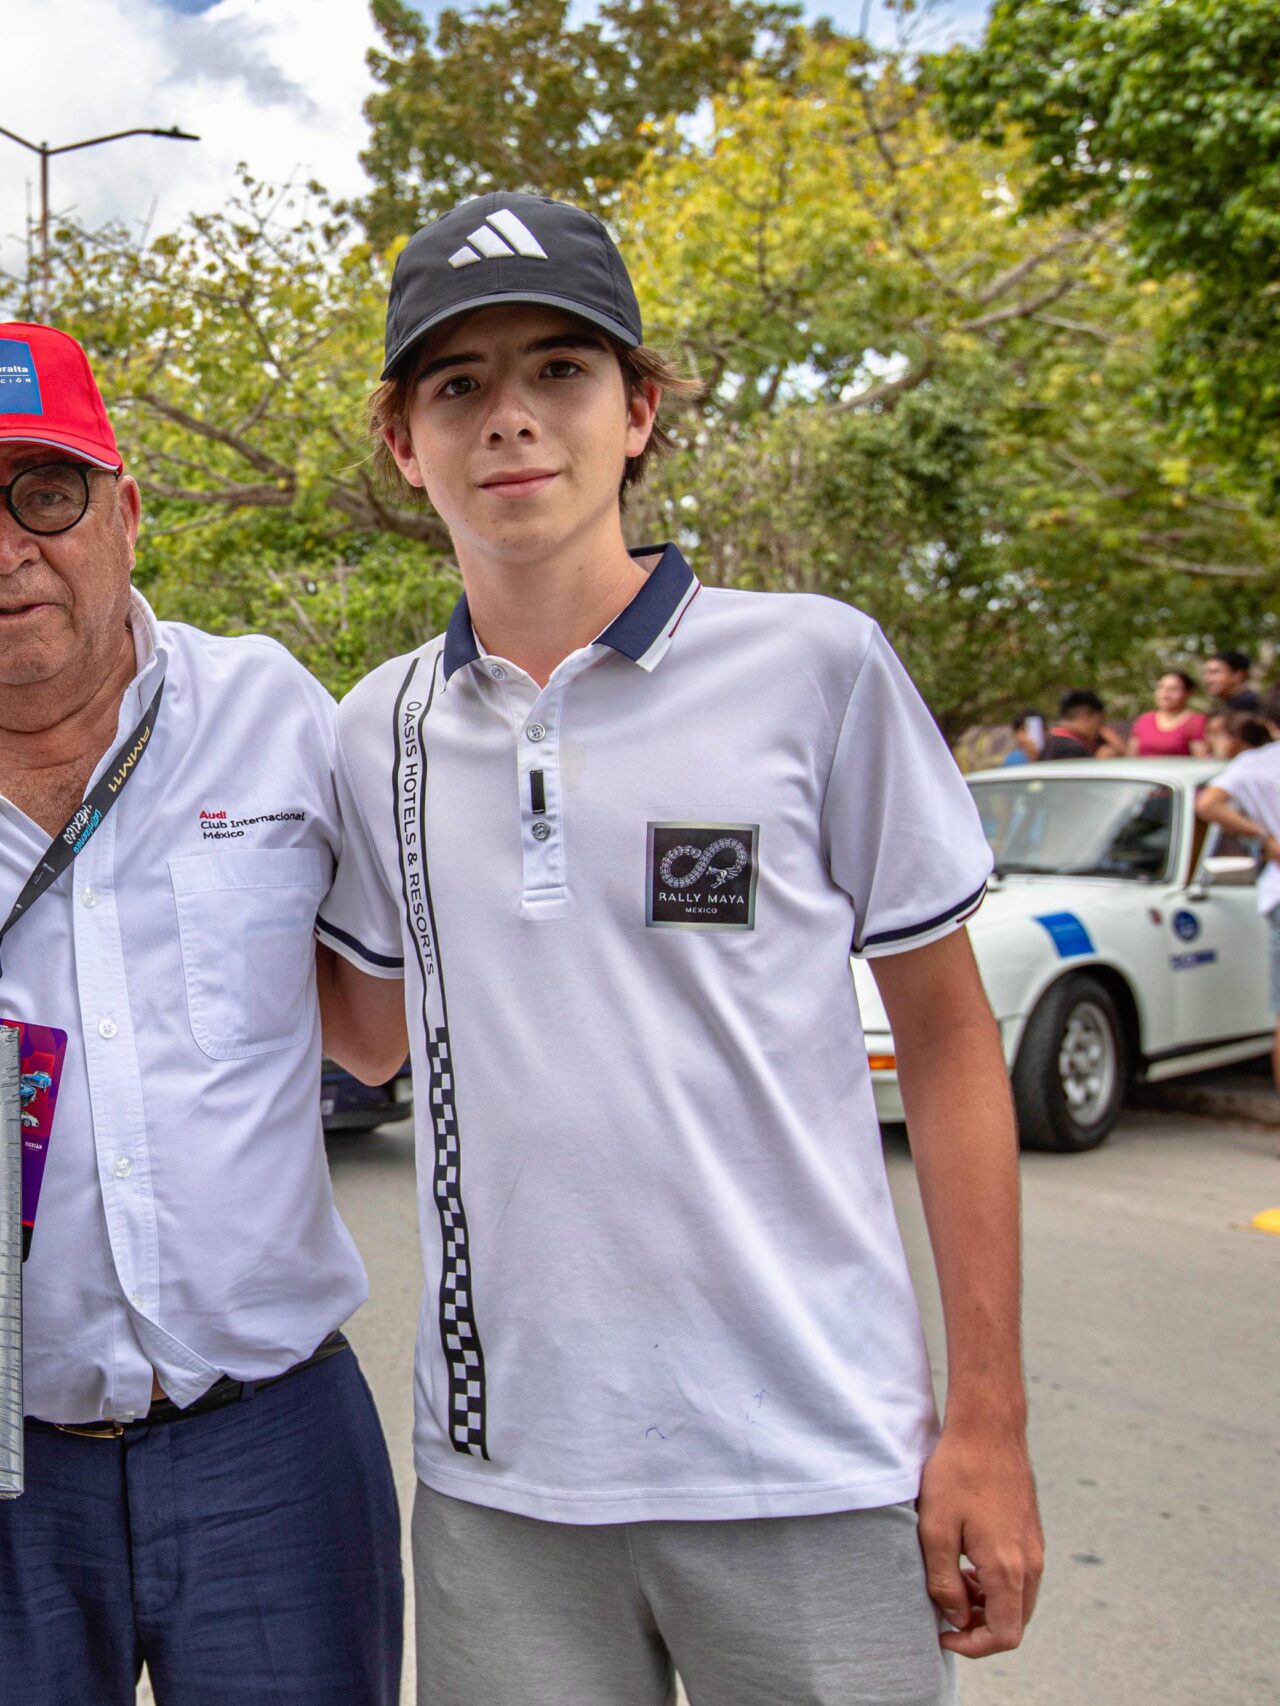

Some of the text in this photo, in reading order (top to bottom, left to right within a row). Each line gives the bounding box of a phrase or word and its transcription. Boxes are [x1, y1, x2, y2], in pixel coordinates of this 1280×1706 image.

[199, 810, 227, 819] Audi
[200, 812, 306, 829] Club Internacional
[202, 830, 245, 840] México
[403, 701, 434, 975] OASIS HOTELS & RESORTS
[658, 892, 745, 904] RALLY MAYA
